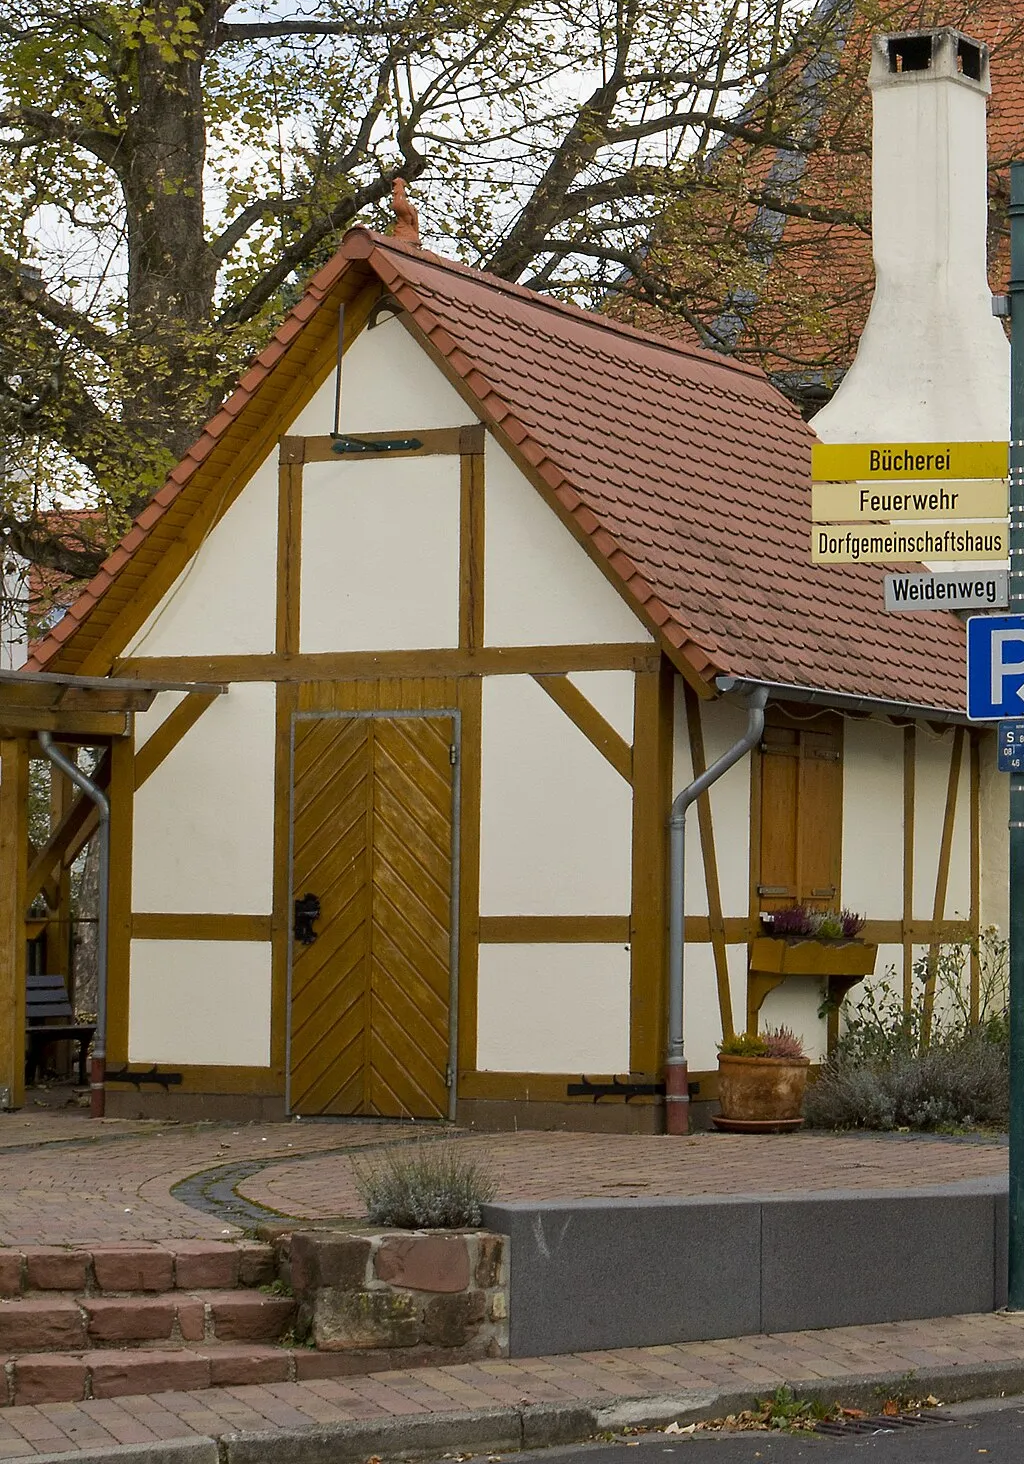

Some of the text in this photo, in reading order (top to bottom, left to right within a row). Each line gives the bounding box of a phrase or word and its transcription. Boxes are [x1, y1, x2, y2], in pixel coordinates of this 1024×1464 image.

[869, 448, 950, 472] Bücherei
[859, 488, 959, 512] Feuerwehr
[818, 530, 1002, 560] Dorfgemeinschaftshaus
[892, 578, 997, 603] Weidenweg
[1006, 731, 1014, 743] S
